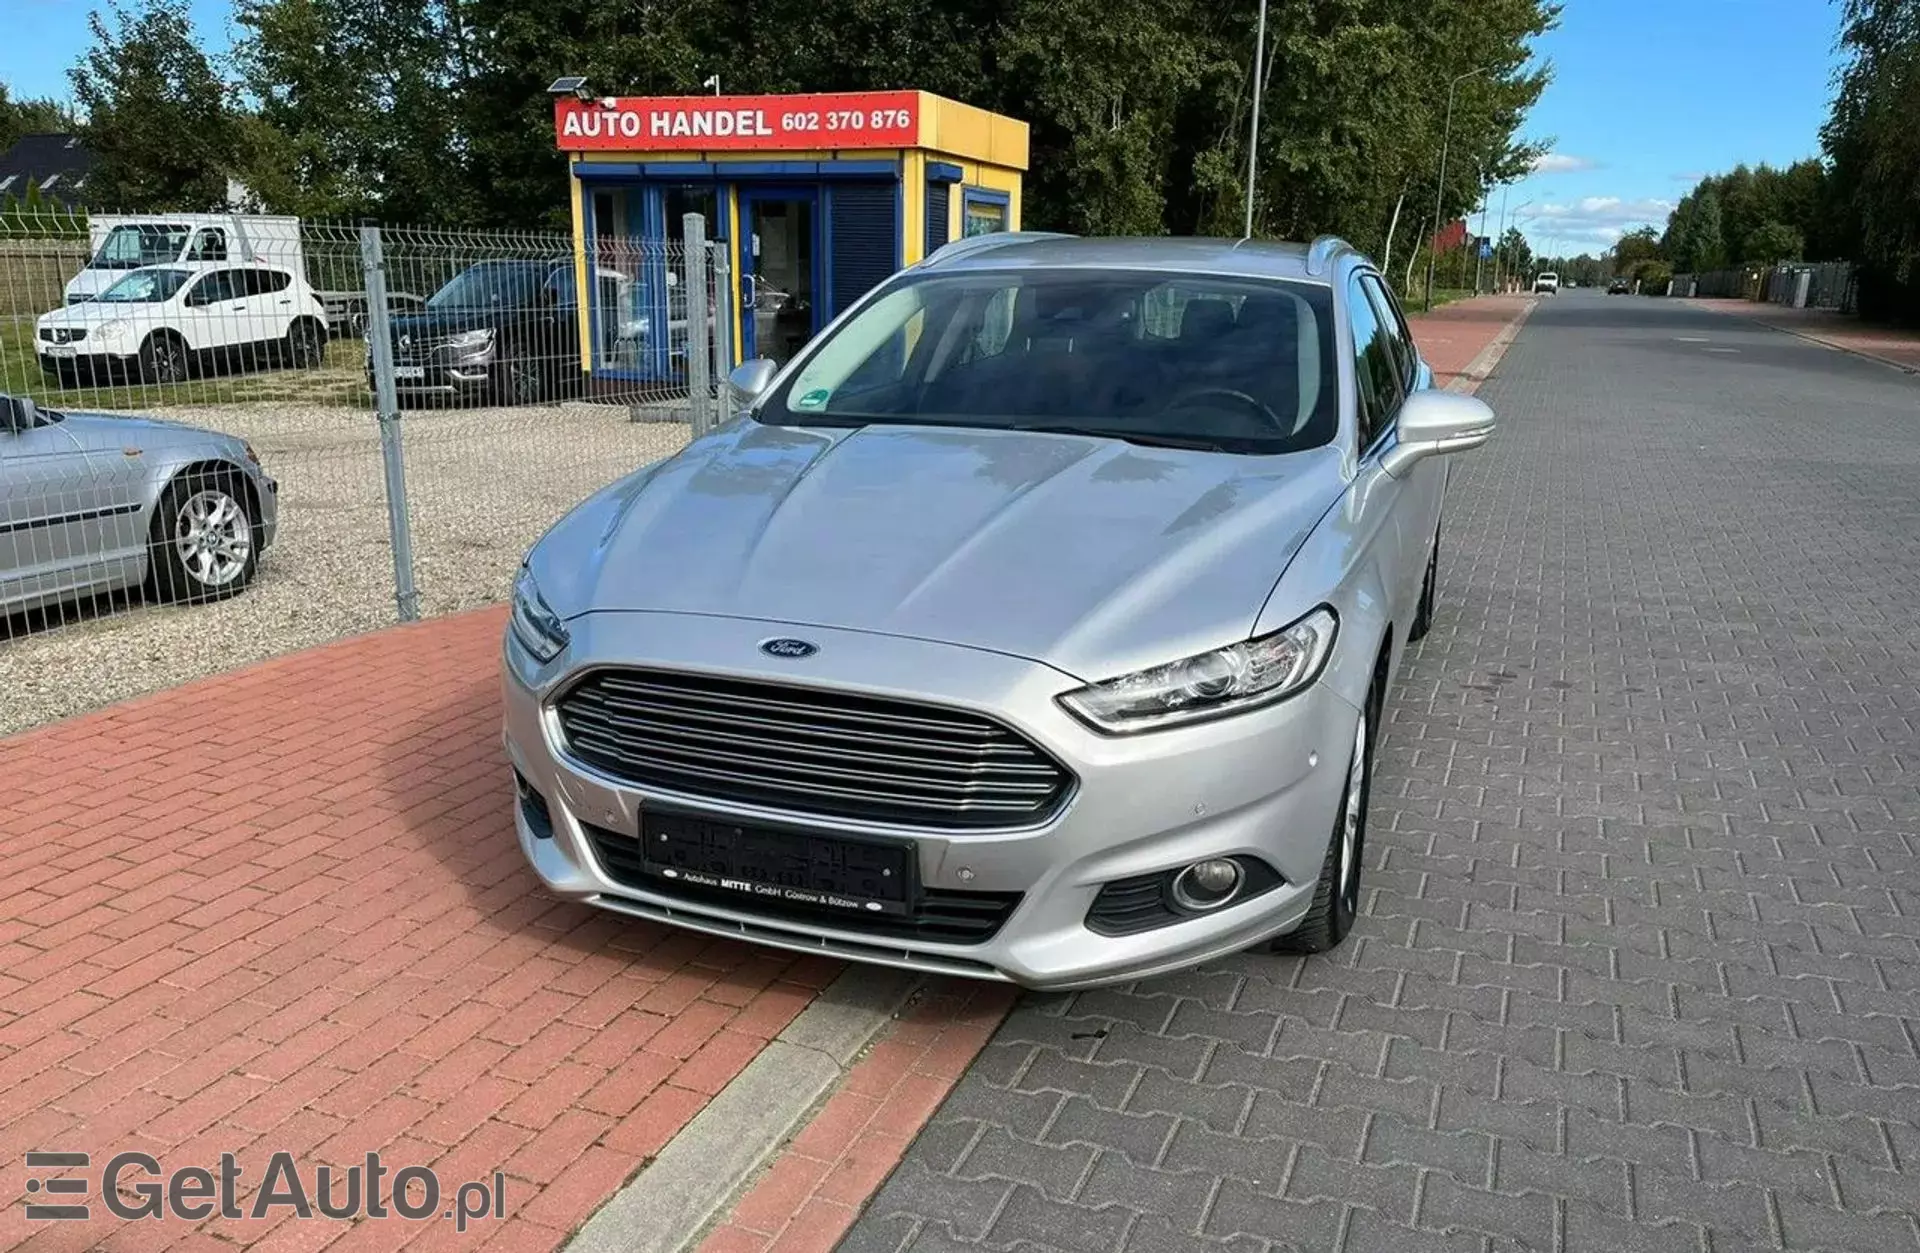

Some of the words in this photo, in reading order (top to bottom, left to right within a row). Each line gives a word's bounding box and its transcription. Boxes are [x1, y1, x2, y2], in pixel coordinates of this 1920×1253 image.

[563, 111, 641, 137] AUTO
[650, 110, 773, 137] HANDEL
[781, 112, 819, 131] 602
[825, 110, 864, 130] 370
[870, 109, 910, 129] 876
[770, 640, 806, 655] Ford
[721, 879, 751, 892] MITTE
[754, 885, 782, 897] GmbH
